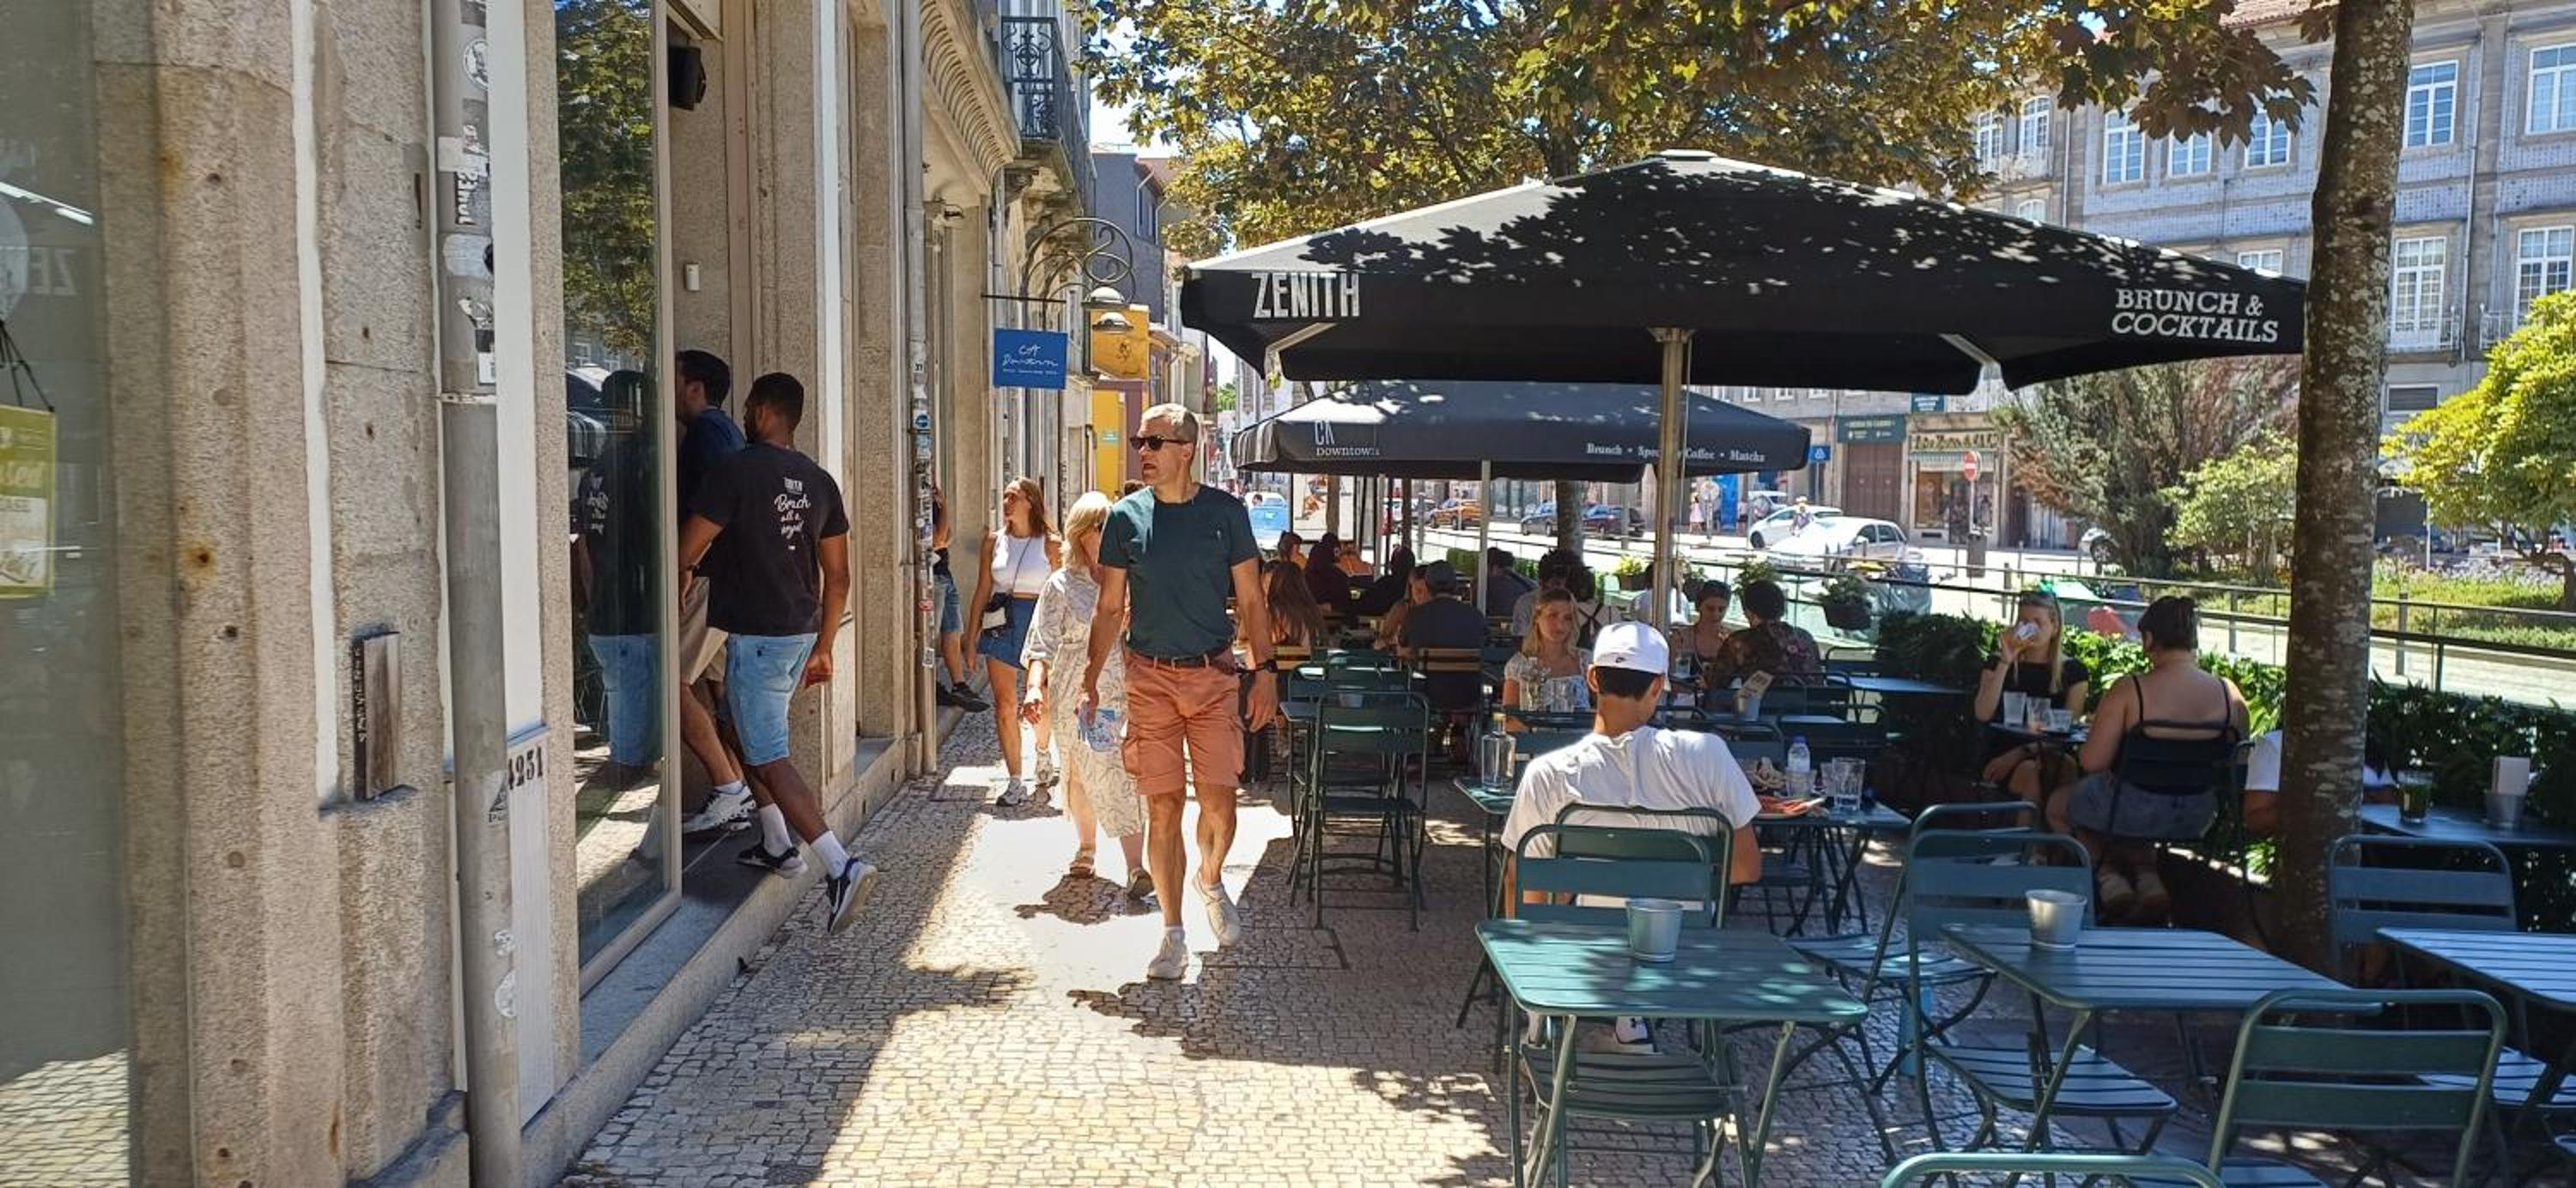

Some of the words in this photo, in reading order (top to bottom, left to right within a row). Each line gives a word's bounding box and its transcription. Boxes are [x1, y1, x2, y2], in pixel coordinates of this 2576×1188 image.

[1251, 271, 1360, 318] ZENITH
[2115, 288, 2239, 315] BRUNCH
[2245, 294, 2264, 316] &
[2111, 312, 2279, 342] COCKTAILS
[1586, 443, 1623, 455] Brunch
[1685, 448, 1715, 460] Coffee
[1729, 450, 1765, 463] Matcha
